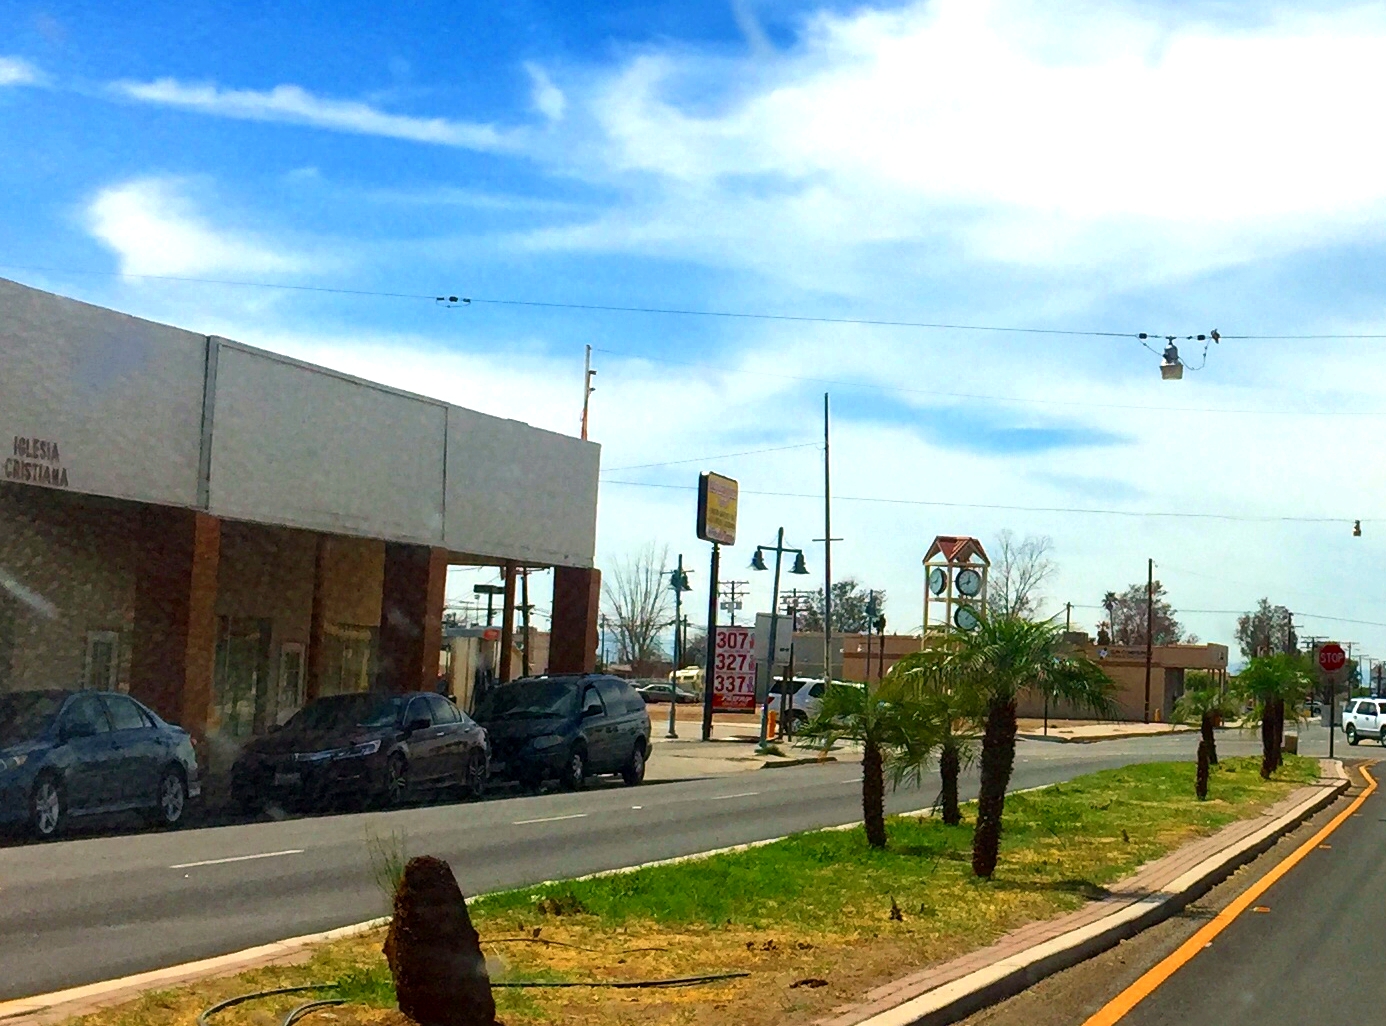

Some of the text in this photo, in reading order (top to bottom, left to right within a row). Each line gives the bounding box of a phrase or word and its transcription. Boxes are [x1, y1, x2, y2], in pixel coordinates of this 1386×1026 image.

[13, 436, 60, 464] IGLESIA
[4, 458, 69, 487] CRISTIANA
[717, 632, 748, 649] 307
[716, 653, 747, 670] 327
[1320, 652, 1343, 663] STOP
[715, 675, 746, 692] 337
